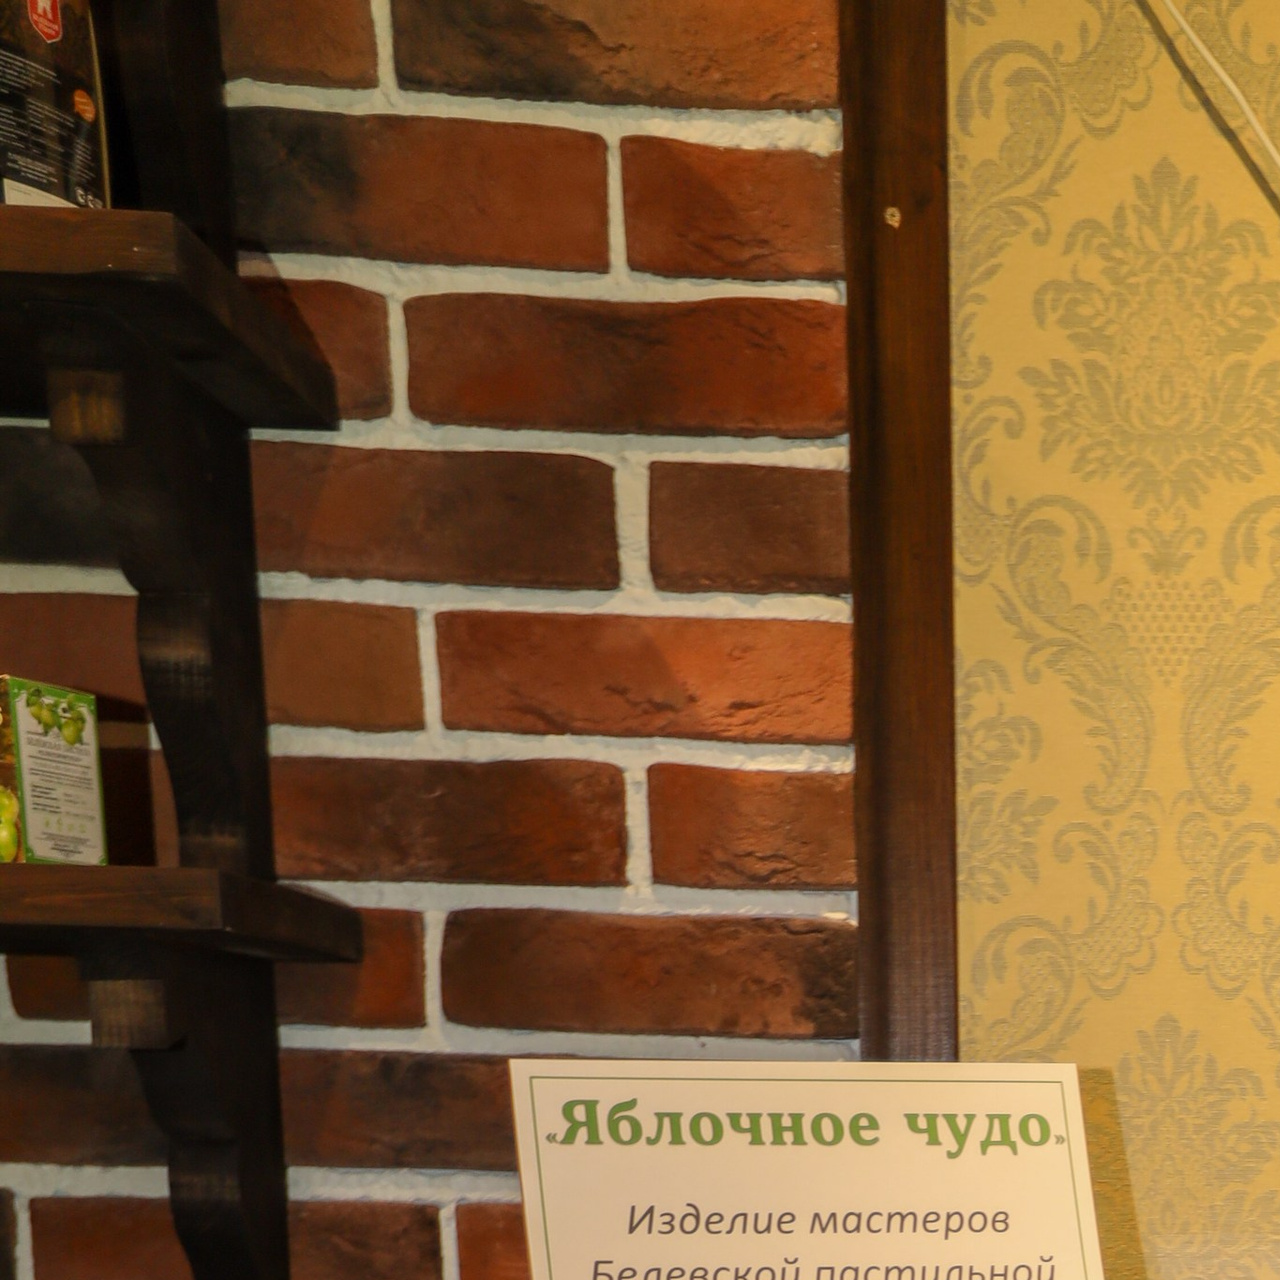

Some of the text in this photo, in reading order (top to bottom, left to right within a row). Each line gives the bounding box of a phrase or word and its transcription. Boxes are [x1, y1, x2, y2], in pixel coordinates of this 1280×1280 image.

[545, 1098, 1066, 1160] «Яблочное чудо»
[627, 1203, 1010, 1241] Изделие мастеров
